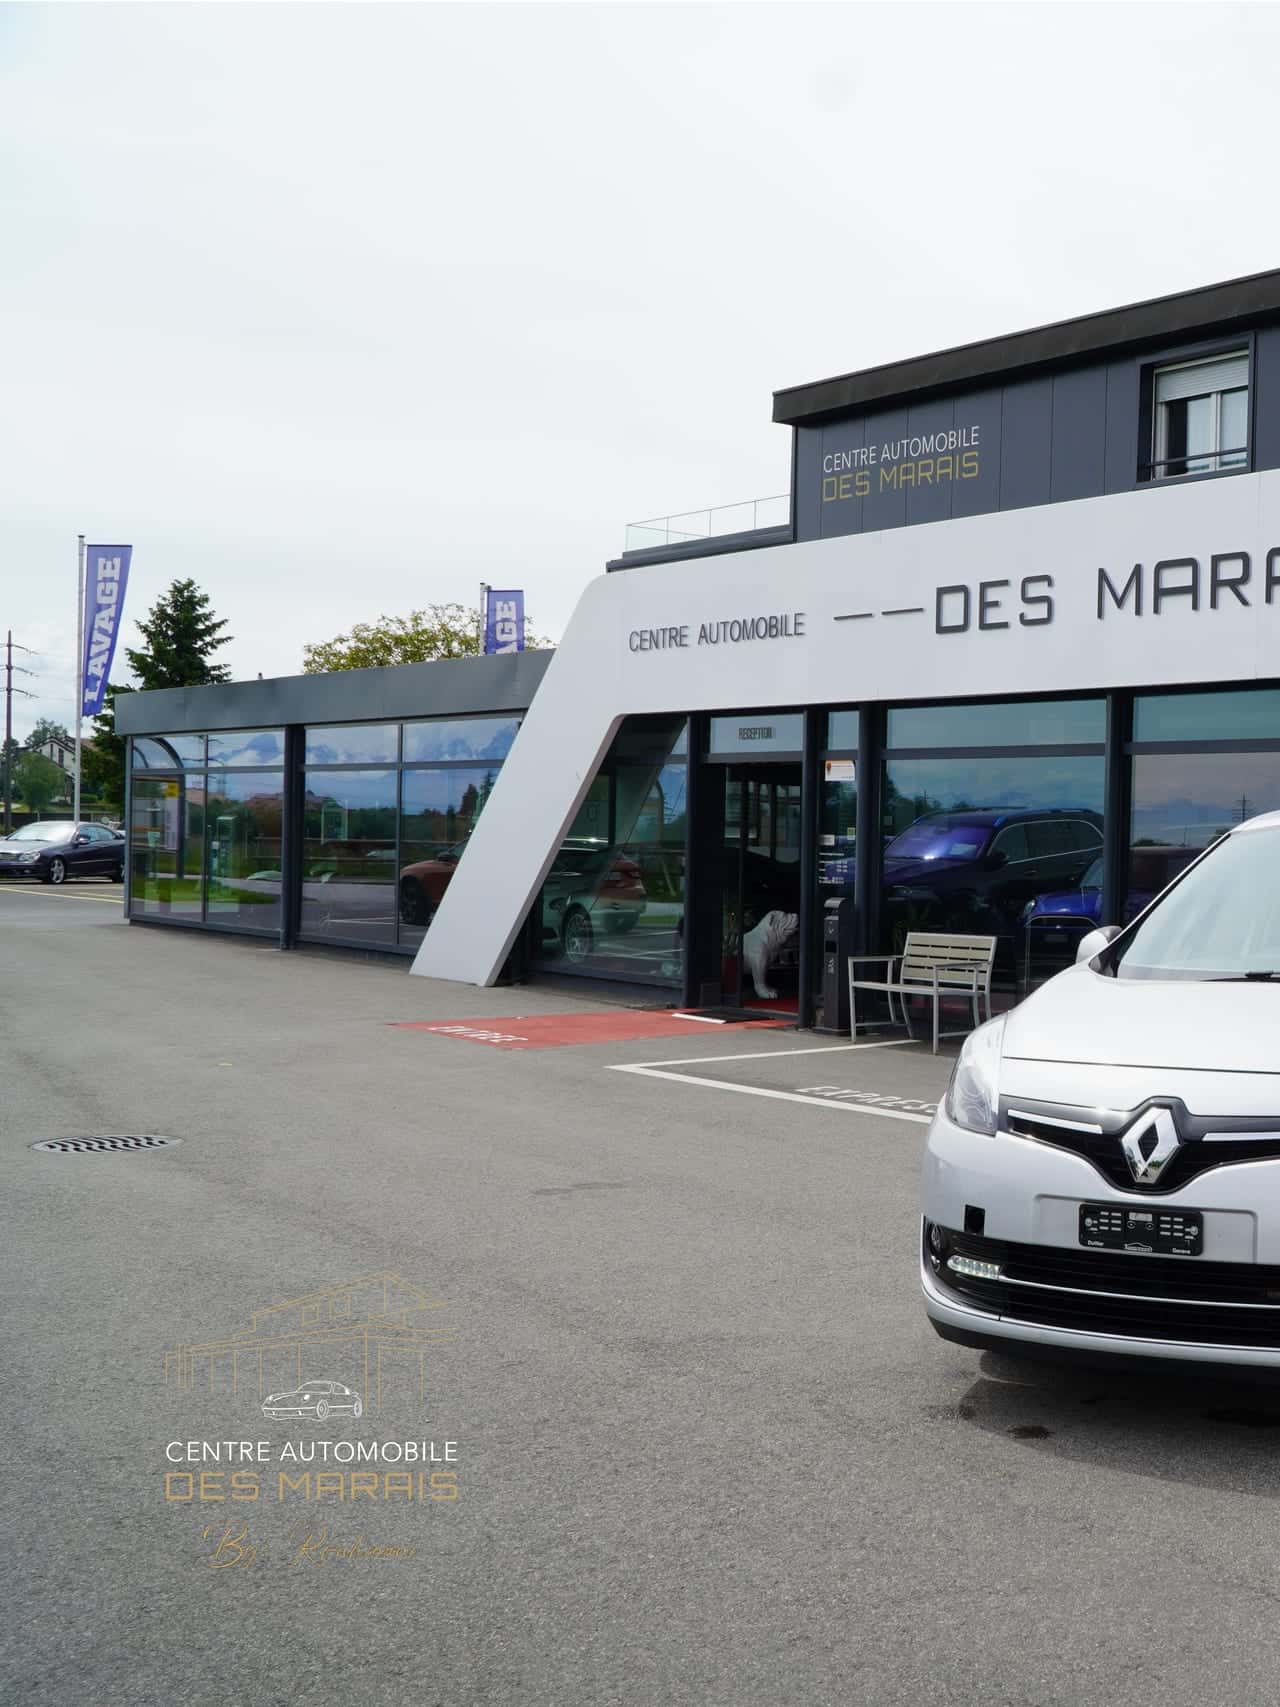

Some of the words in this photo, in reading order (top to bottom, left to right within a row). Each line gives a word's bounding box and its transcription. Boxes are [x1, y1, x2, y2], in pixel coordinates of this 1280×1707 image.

[823, 446, 877, 473] CENTRE
[880, 425, 980, 463] AUTOMOBILE
[823, 470, 871, 502] DES
[879, 451, 979, 493] MARAIS
[84, 556, 121, 704] LAVAGE
[629, 625, 690, 652] CENTRE
[697, 612, 807, 646] AUTOMOBILE
[935, 574, 1055, 635] DES
